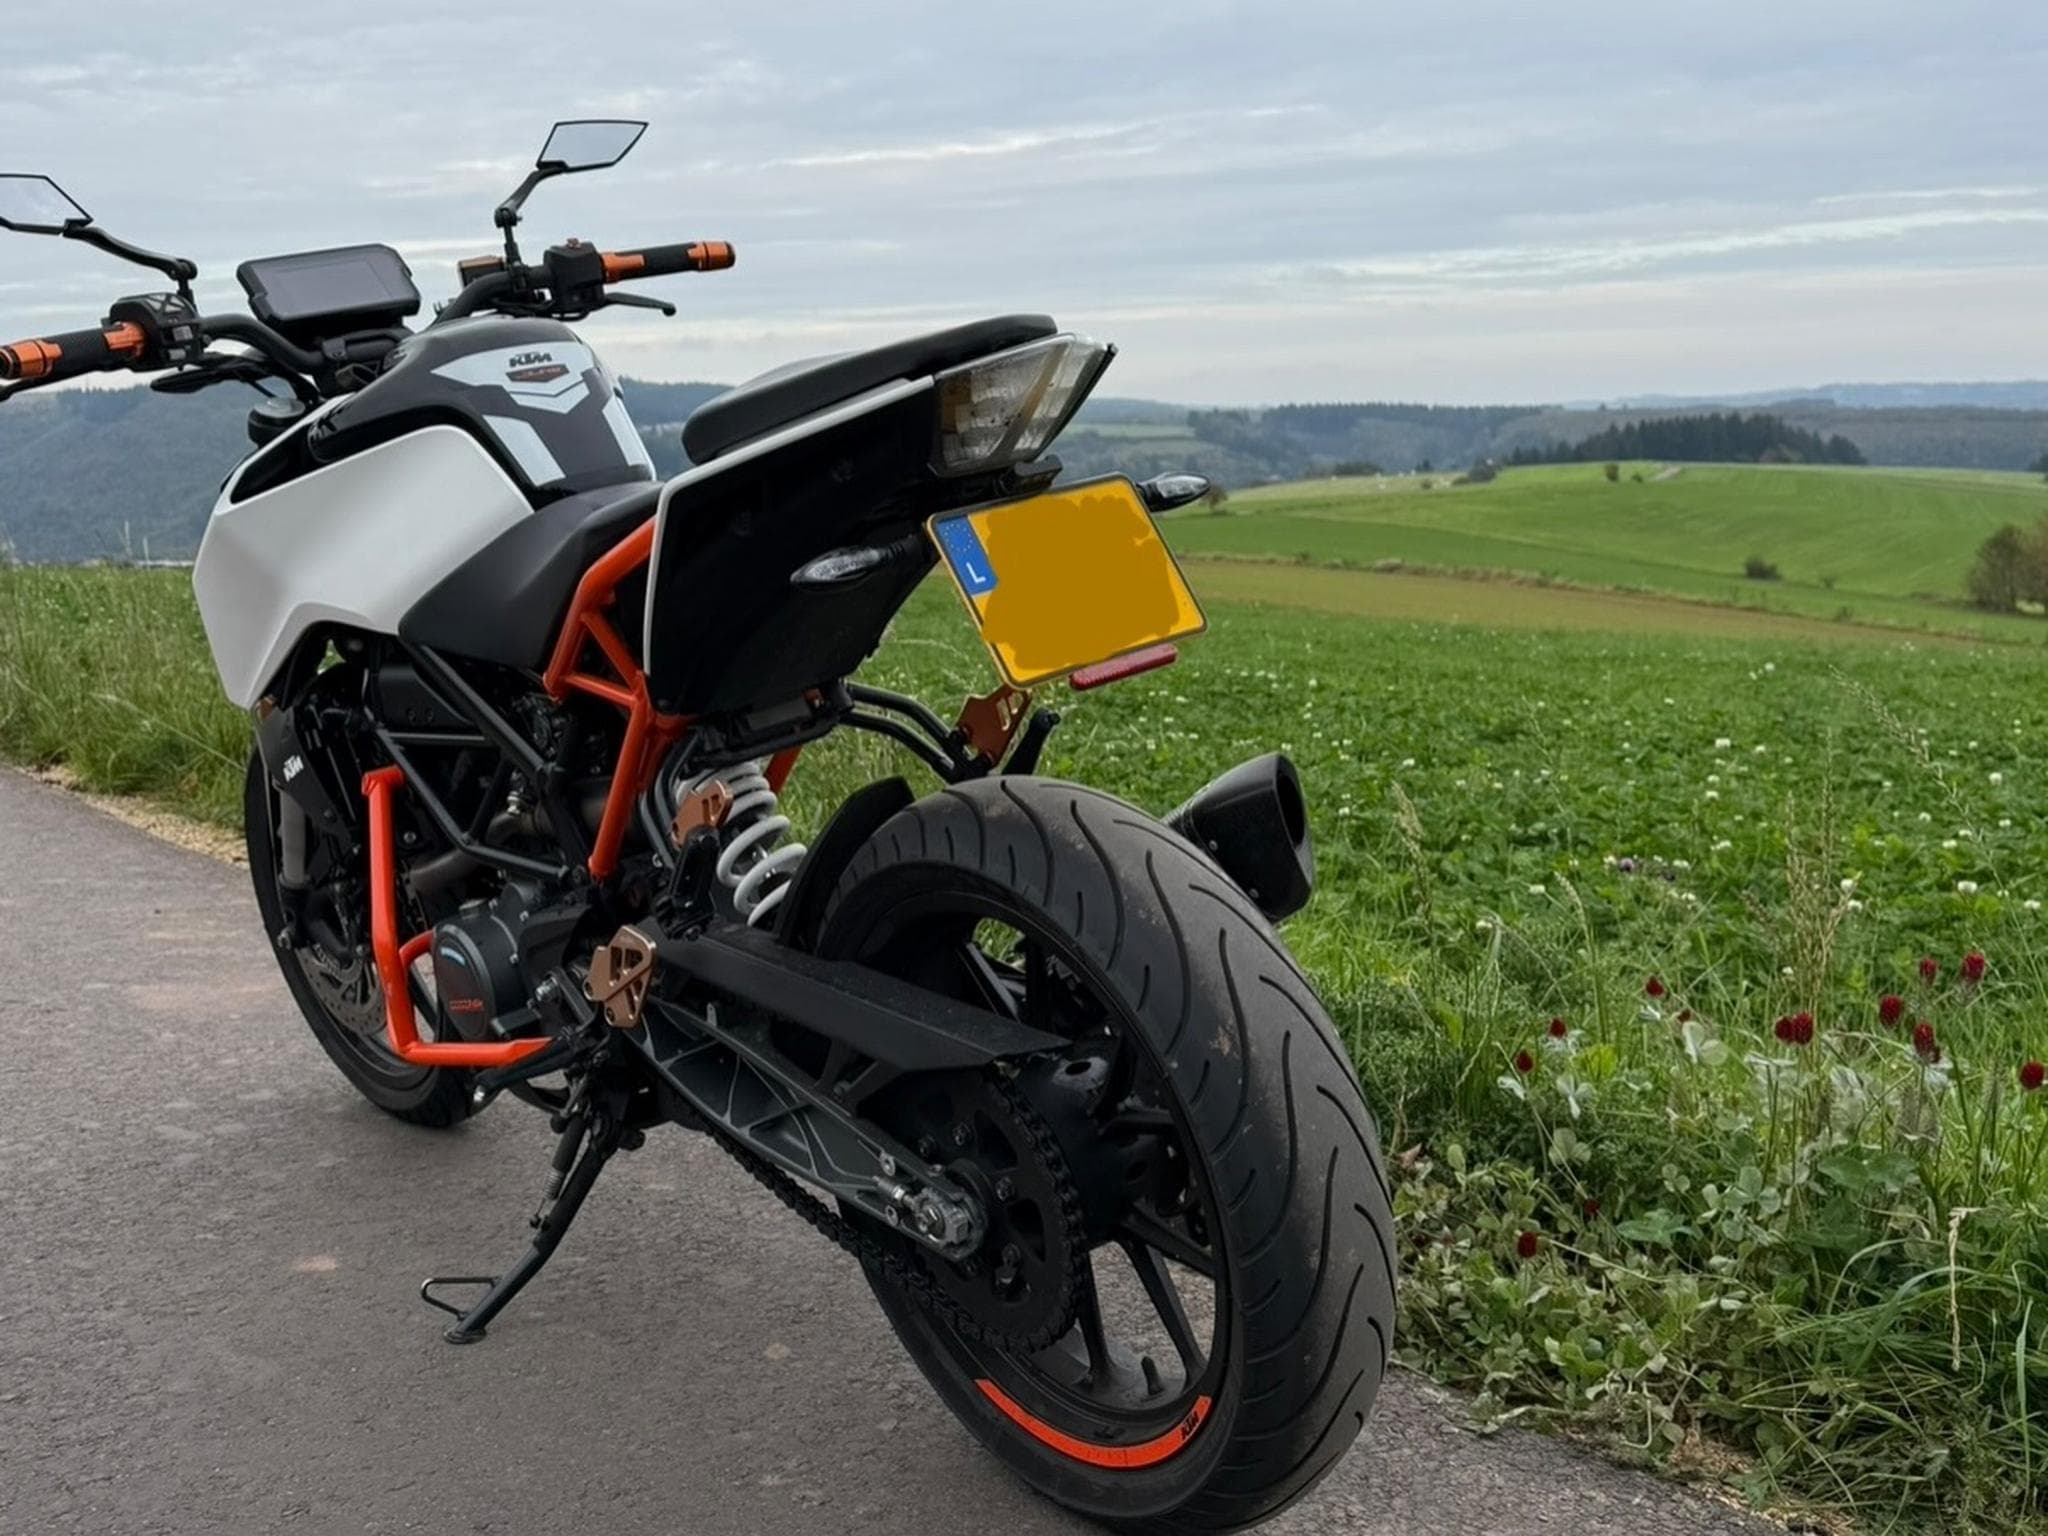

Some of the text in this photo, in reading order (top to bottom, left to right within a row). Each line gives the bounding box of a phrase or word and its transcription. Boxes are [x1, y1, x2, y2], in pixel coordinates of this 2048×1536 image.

[509, 352, 553, 368] KTM
[966, 562, 986, 583] L
[283, 755, 304, 782] KTM
[1181, 1410, 1200, 1440] KTM
